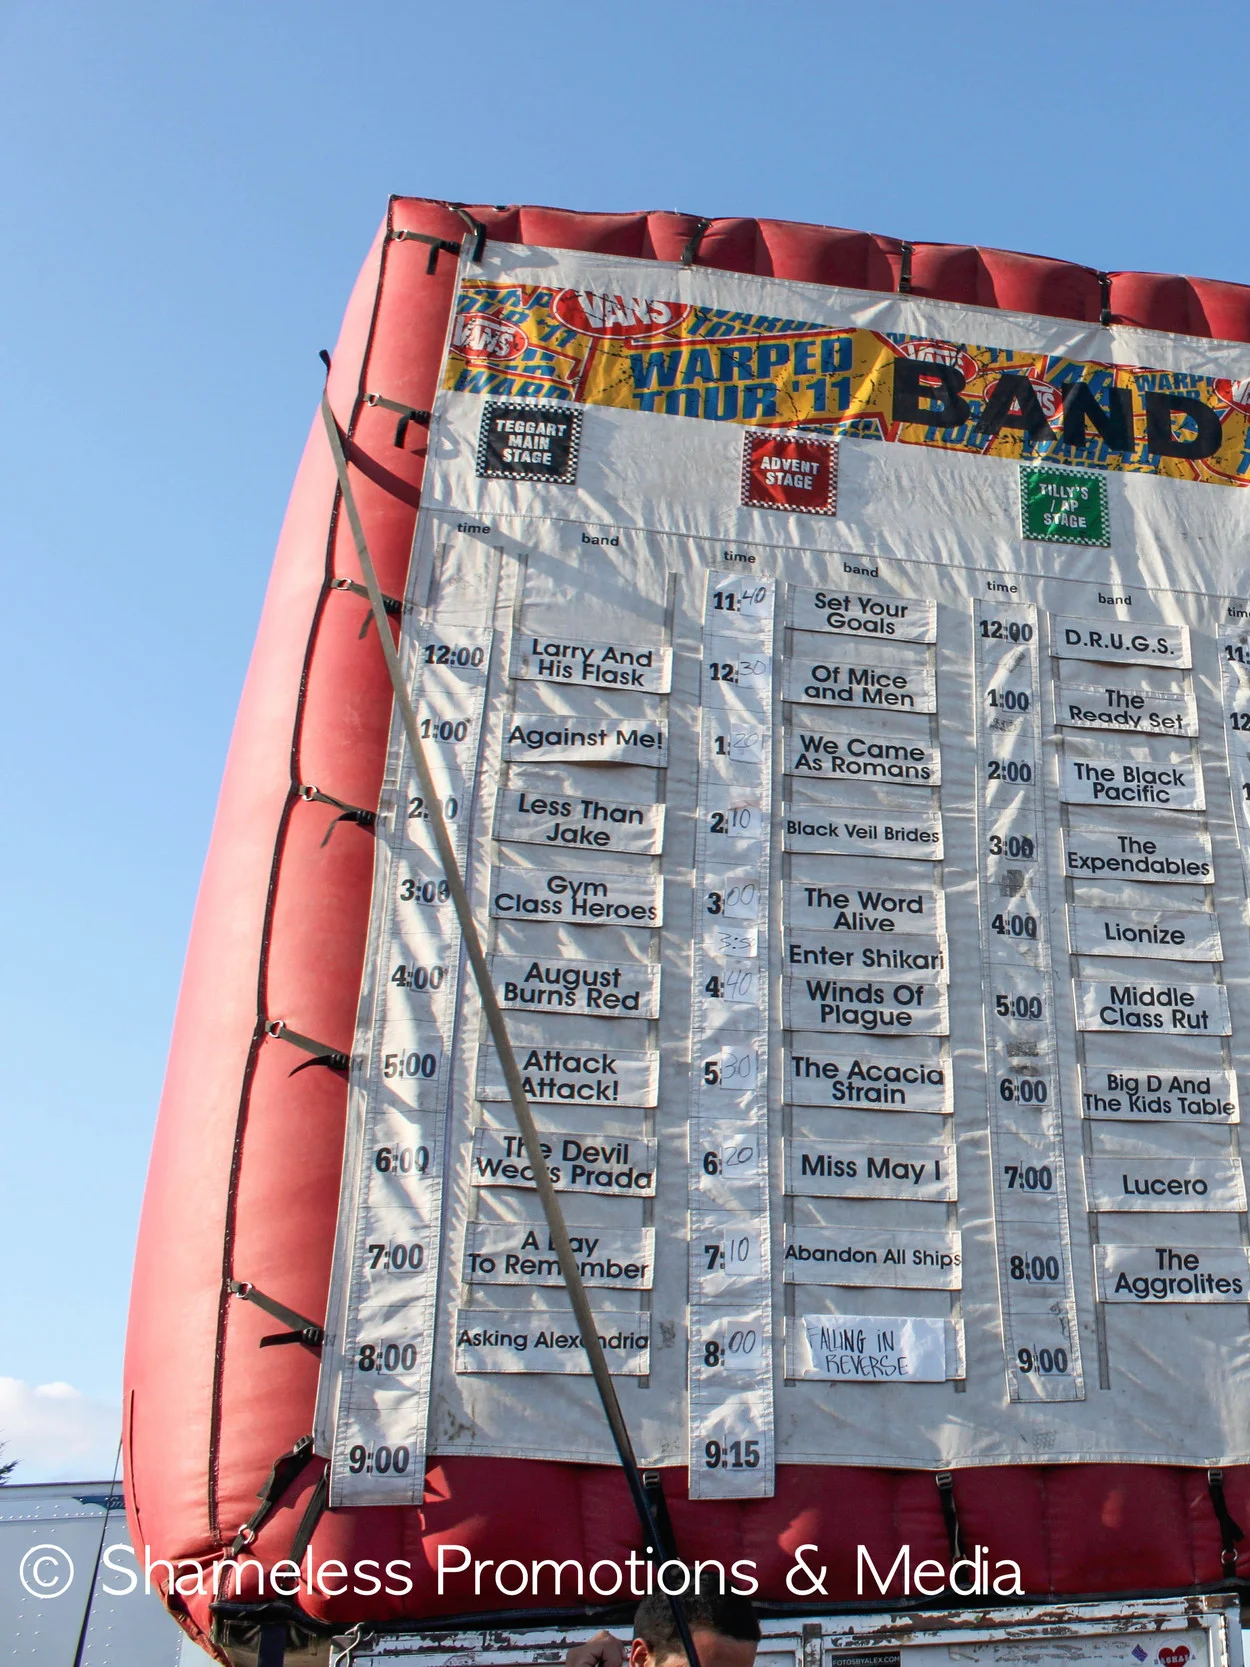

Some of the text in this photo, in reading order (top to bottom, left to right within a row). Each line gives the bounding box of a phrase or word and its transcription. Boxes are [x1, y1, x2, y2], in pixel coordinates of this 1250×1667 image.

[577, 290, 672, 328] VANS
[629, 334, 853, 388] WARPED
[631, 376, 853, 422] TOUR '11
[892, 357, 1223, 460] BAND
[495, 419, 567, 437] TEGGART
[508, 434, 550, 450] MAIN
[502, 448, 552, 465] STAGE
[760, 456, 820, 476] ADVENT
[765, 471, 813, 490] STAGE
[1039, 484, 1088, 500] TILLY'S
[1060, 500, 1079, 512] AP
[1043, 513, 1087, 528] STAGE
[457, 523, 620, 548] time band
[814, 593, 908, 618] Set Your
[826, 612, 895, 635] Goals
[532, 638, 653, 668] Larry And
[1065, 629, 1175, 655] D.R.U.G.S.
[424, 644, 485, 667] 12:00
[538, 658, 645, 687] His Flask
[811, 665, 907, 689] Of Mice
[805, 684, 914, 707] and Men
[1105, 689, 1144, 709] The
[420, 718, 469, 742] 1:00
[1069, 705, 1183, 730] Ready Set
[508, 725, 663, 750] Against Me!
[800, 735, 925, 761] We Came
[795, 754, 931, 780] As Romans
[1073, 763, 1186, 786] The Black
[1093, 782, 1170, 803] Pacific
[519, 793, 644, 825] Less Than
[546, 823, 611, 847] Jake
[787, 821, 939, 842] Black Veil Brides
[547, 876, 608, 899] Gym
[495, 893, 657, 920] Class Heroes
[804, 887, 924, 914] The Word
[833, 911, 895, 932] Alive
[1104, 922, 1185, 945] Lionize
[789, 945, 945, 970] Enter Shikari
[391, 964, 444, 990] 4:00
[524, 962, 621, 991] August
[504, 983, 640, 1011] Burns Red
[806, 980, 924, 1006] Winds Of
[820, 1004, 912, 1030] Plague
[384, 1052, 436, 1079] 5:00
[523, 1050, 617, 1075] Attack
[792, 1056, 944, 1085] The Acacia
[522, 1078, 618, 1101] Attack!
[832, 1081, 906, 1104] Strain
[801, 1154, 941, 1185] Miss May I
[1122, 1174, 1208, 1195] Lucero
[368, 1243, 424, 1270] 7:00
[785, 1245, 960, 1267] Abandon All Ships
[1010, 1256, 1059, 1281] 8:00
[1155, 1248, 1199, 1270] The
[1114, 1272, 1243, 1299] Aggrolites
[358, 1343, 417, 1372] 8:00
[349, 1445, 410, 1474] 9:00
[704, 1440, 760, 1468] 9:15
